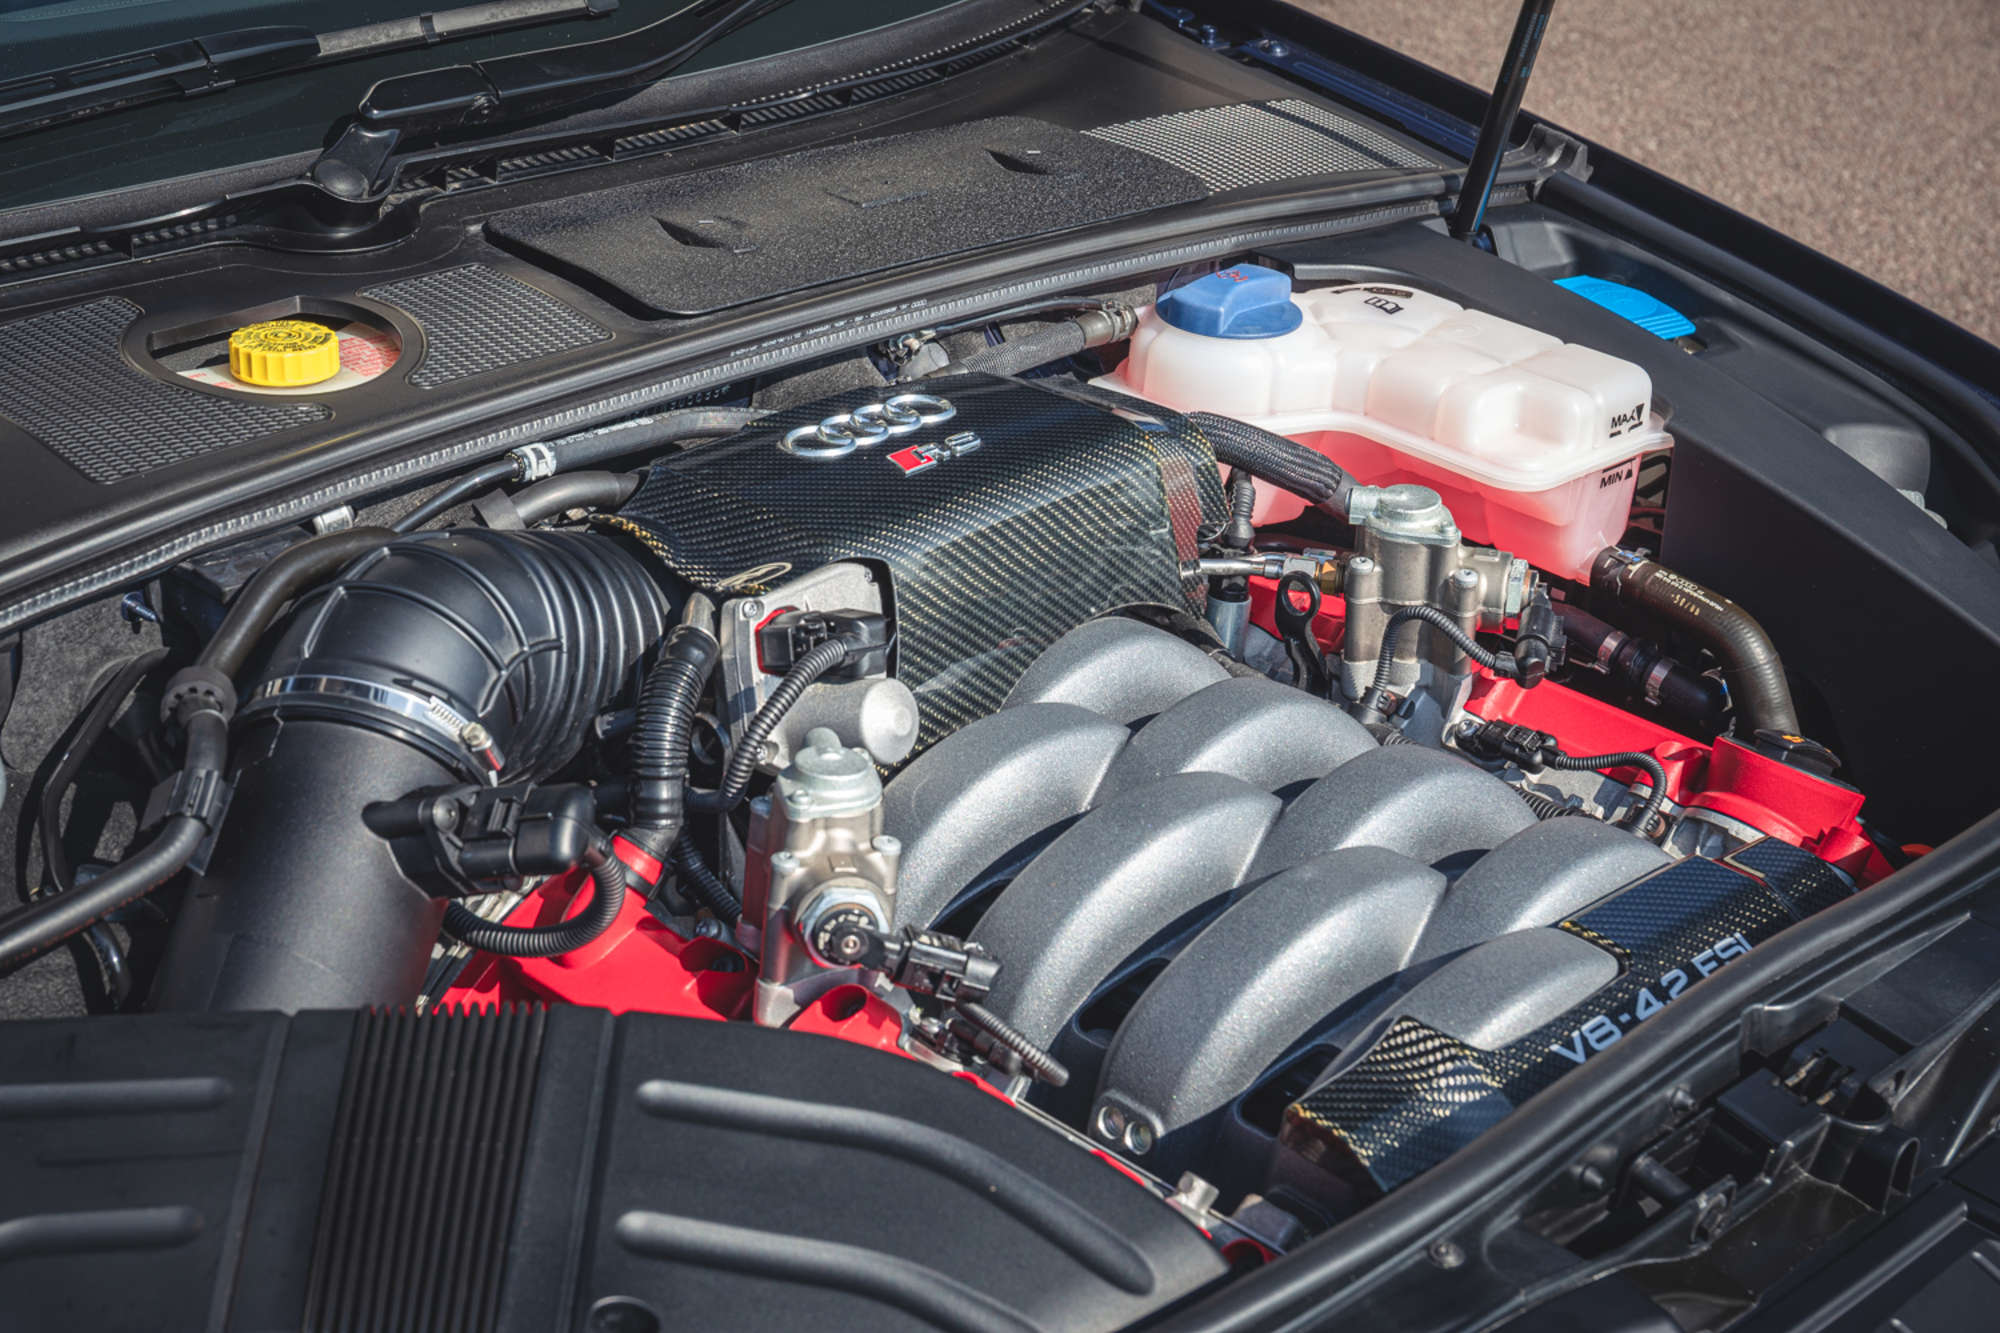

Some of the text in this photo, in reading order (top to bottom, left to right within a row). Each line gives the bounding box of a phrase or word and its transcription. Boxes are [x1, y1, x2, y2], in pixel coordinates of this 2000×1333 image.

[1610, 408, 1636, 429] MAX
[1600, 470, 1623, 488] MIN
[1690, 931, 1753, 978] FSI
